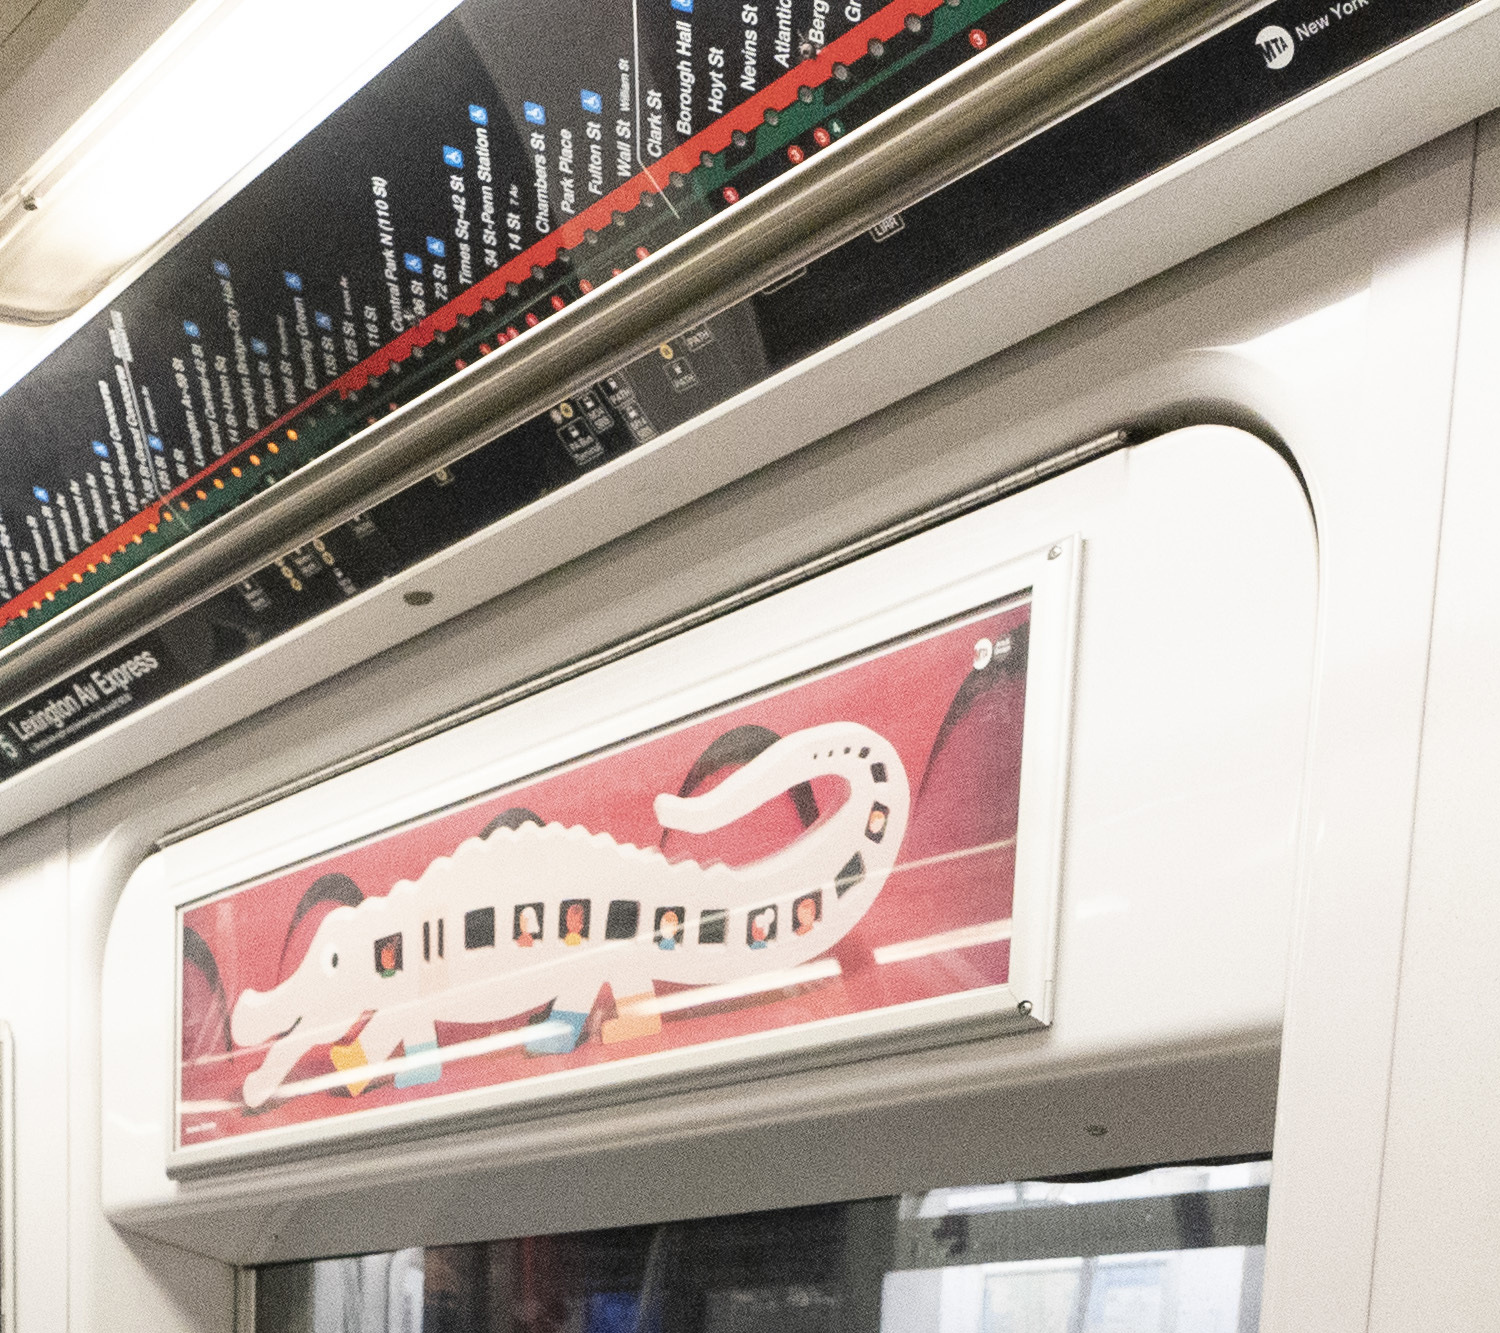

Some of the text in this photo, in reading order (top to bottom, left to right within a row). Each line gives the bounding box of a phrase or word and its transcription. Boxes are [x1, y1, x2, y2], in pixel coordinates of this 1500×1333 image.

[741, 4, 759, 91] Nevins St
[1295, 14, 1330, 41] New
[676, 21, 696, 136] Borough Hall
[708, 47, 725, 114] Hoyt St
[587, 121, 603, 196] Fulton St
[616, 119, 632, 143] St
[647, 89, 663, 159] Clark St
[530, 132, 550, 233] Chambers St
[559, 129, 575, 215] Park Place
[616, 145, 631, 178] Wall
[450, 175, 473, 284] Times Sq-42 St
[475, 128, 499, 268] 34 St-Penn Station
[506, 213, 522, 250] 14 St
[371, 176, 404, 332] Central Park N (110 St)
[410, 280, 424, 297] St
[433, 264, 448, 301] 72 St
